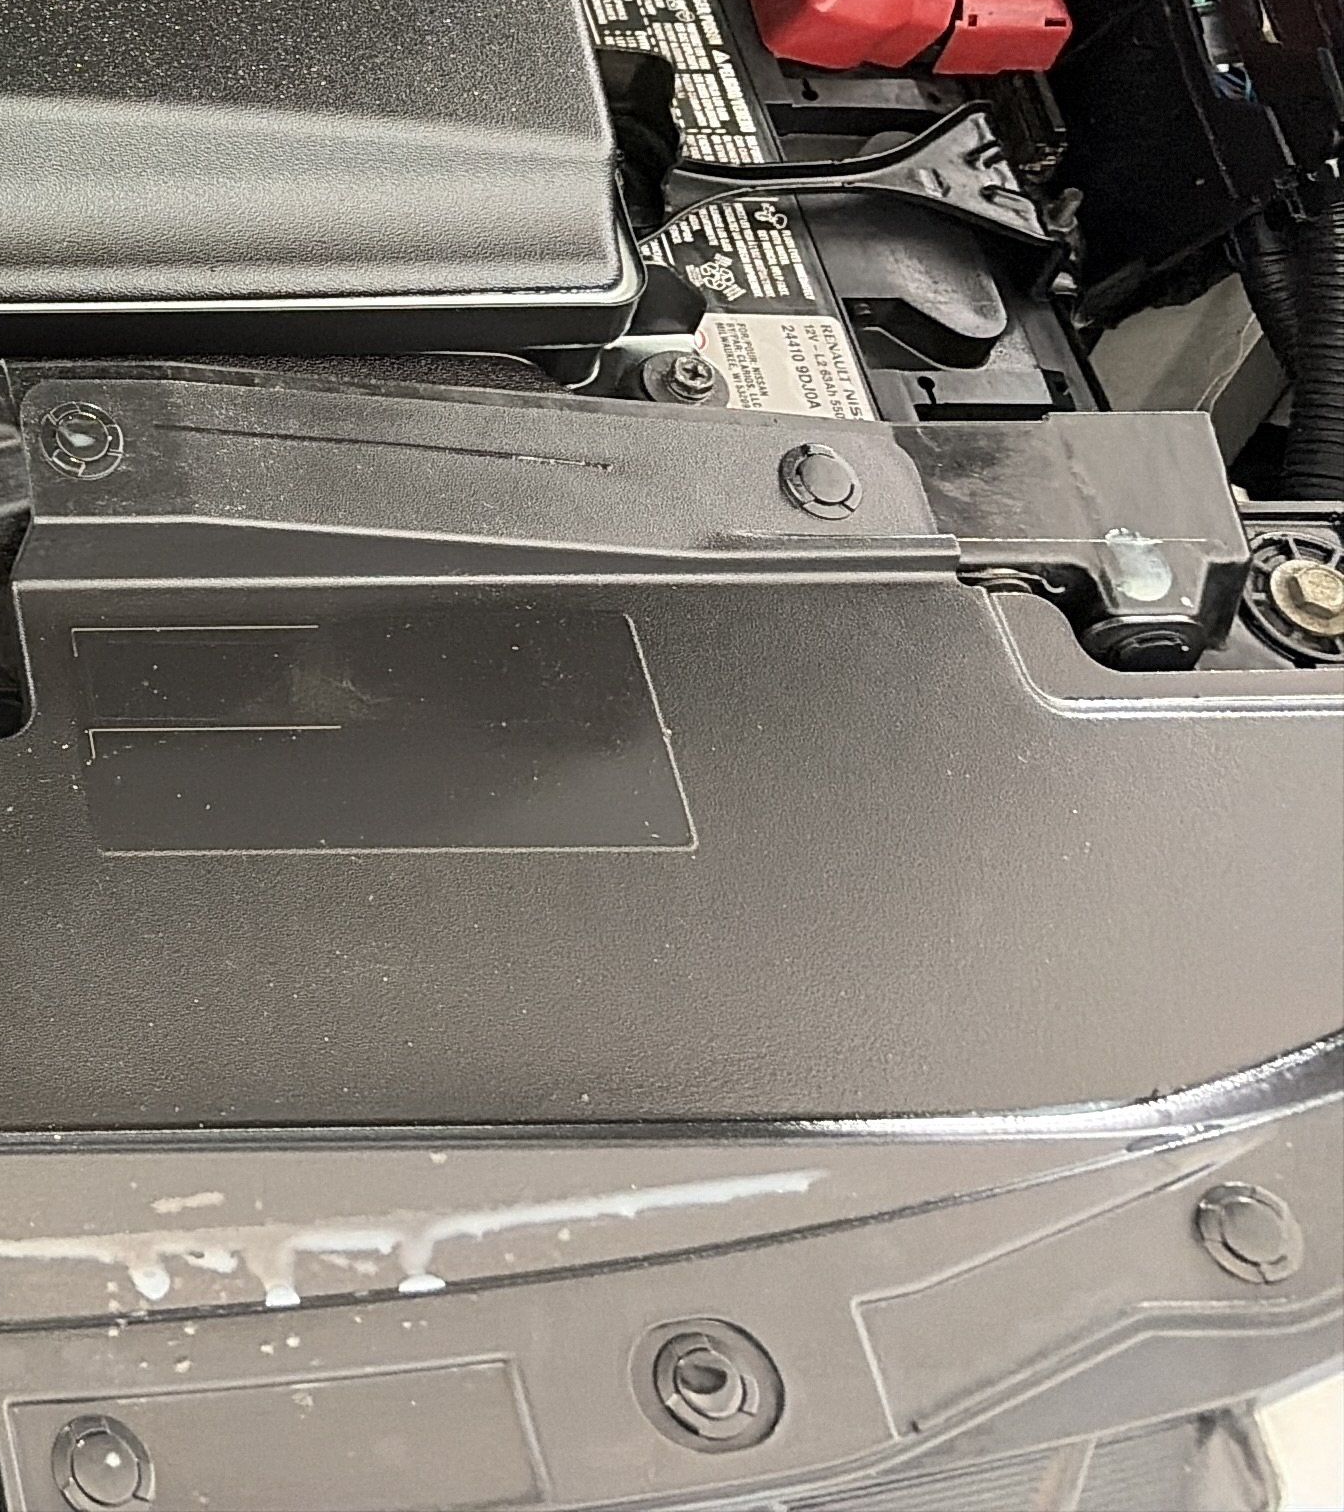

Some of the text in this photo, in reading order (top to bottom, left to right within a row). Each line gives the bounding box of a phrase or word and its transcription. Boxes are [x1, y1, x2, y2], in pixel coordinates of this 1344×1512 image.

[781, 325, 806, 362] 24410
[804, 324, 820, 342] 12V
[814, 354, 827, 367] L2
[732, 373, 741, 383] WI
[752, 368, 769, 397] NISSAN
[820, 324, 864, 421] RENAULT NIS
[820, 370, 837, 396] 63Ah
[750, 393, 762, 408] LLC
